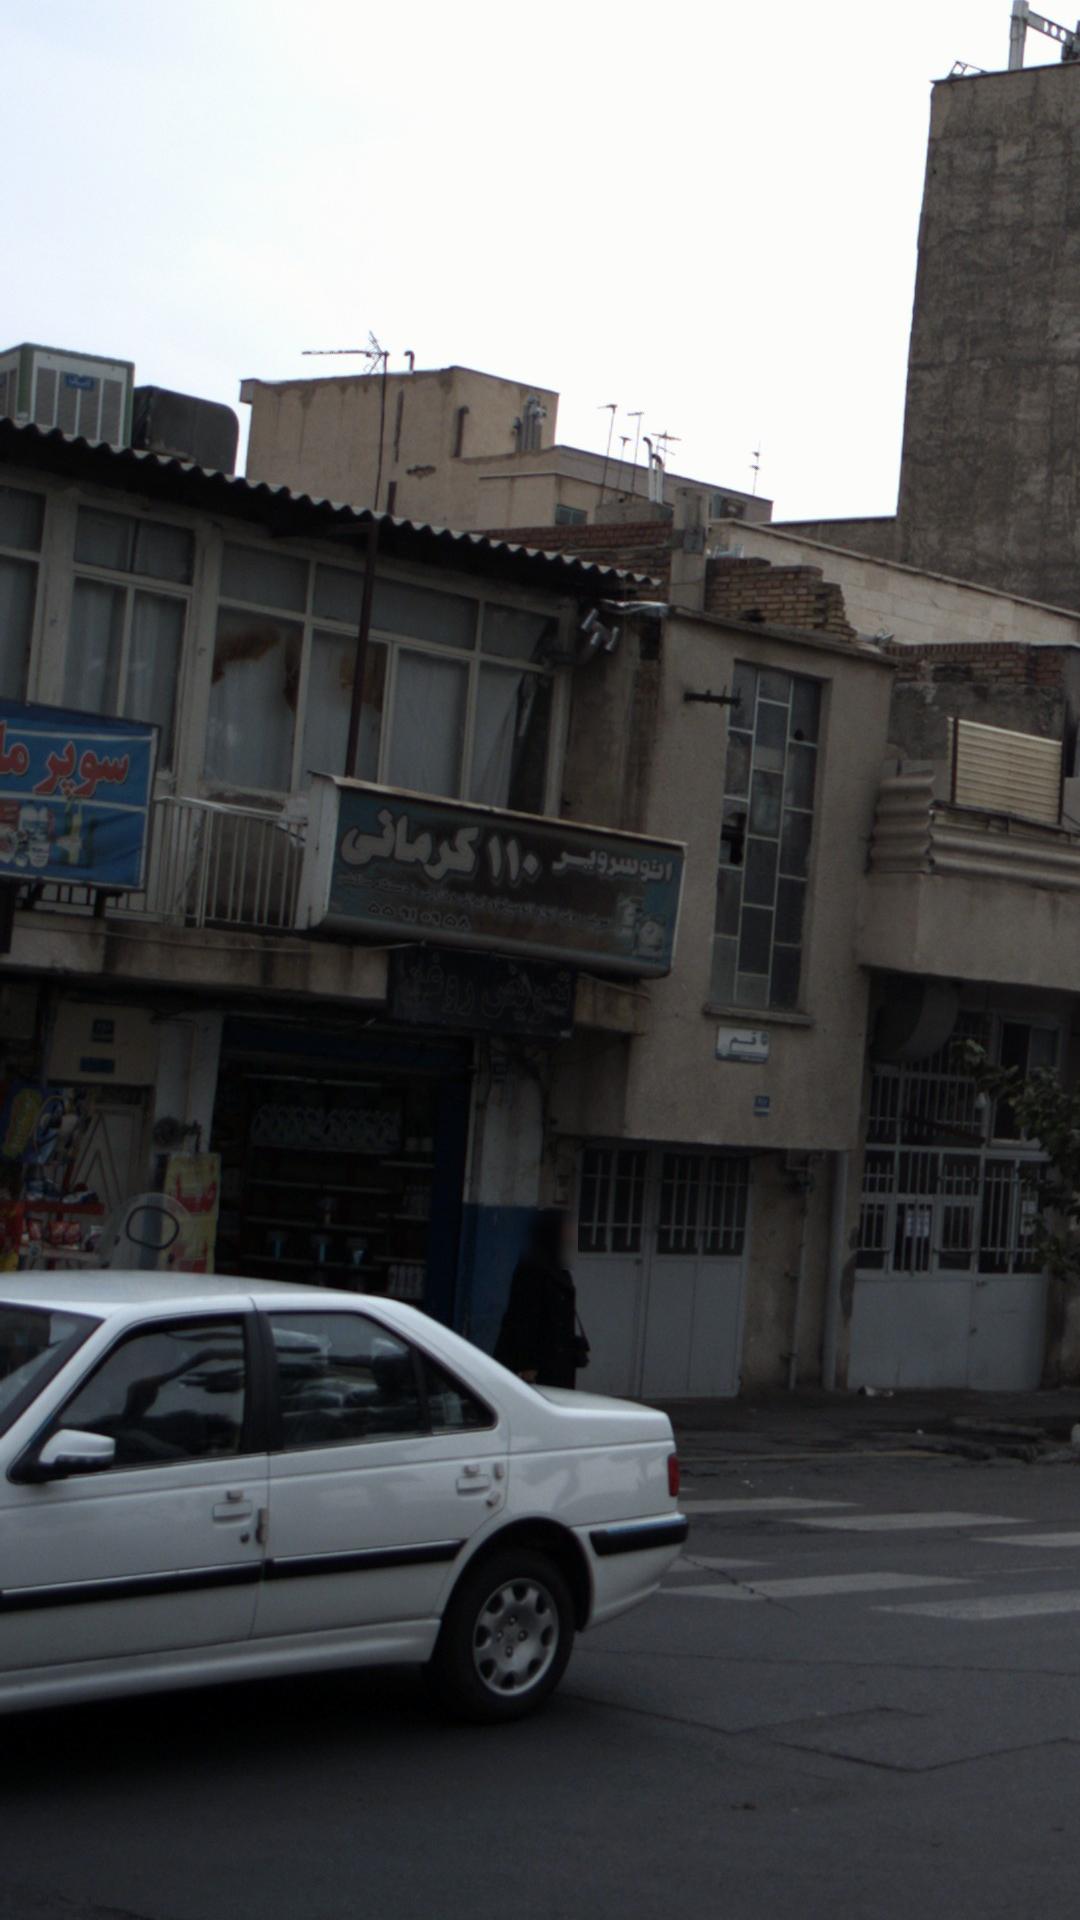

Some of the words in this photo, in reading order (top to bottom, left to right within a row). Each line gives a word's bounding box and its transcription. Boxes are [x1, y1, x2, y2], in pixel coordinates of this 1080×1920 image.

[32, 740, 130, 798] سوپر
[341, 808, 481, 881] کرمانی
[487, 834, 541, 882] ۱۱۰
